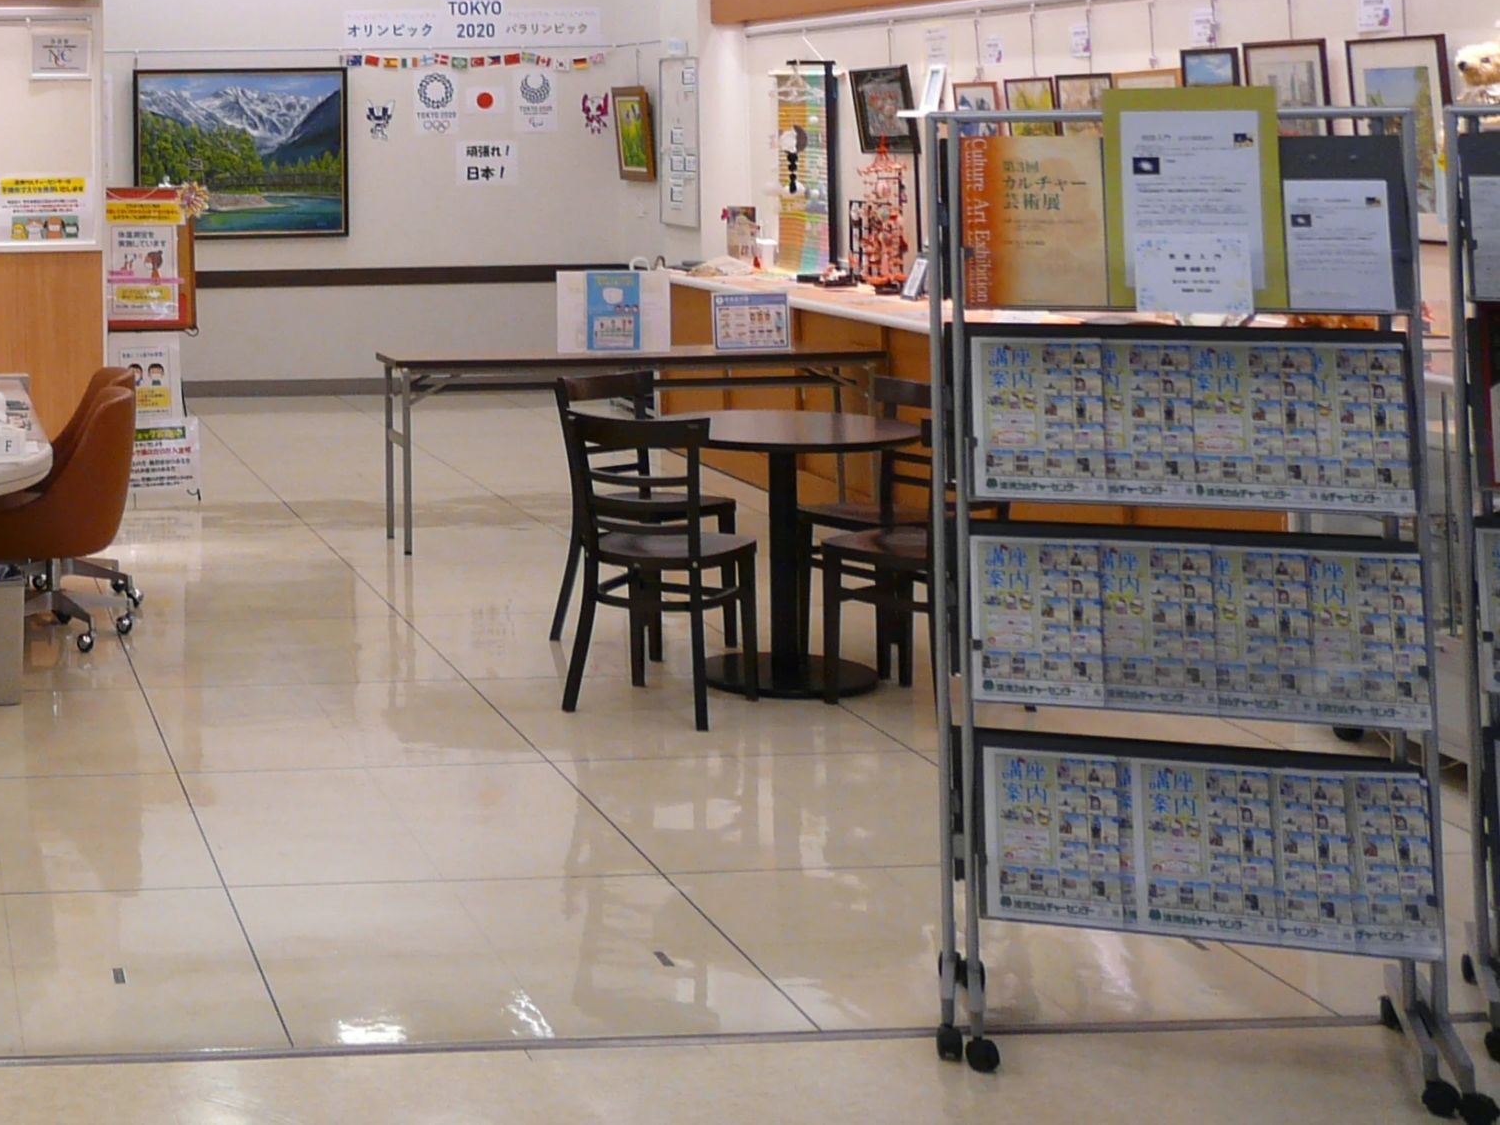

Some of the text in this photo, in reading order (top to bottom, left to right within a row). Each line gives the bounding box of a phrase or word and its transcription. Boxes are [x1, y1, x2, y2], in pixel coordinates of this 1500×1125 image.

[448, 0, 502, 16] TOKYO
[347, 23, 433, 38] オリンピック
[456, 22, 496, 38] 2020
[417, 111, 457, 119] TOKYO 2020
[467, 165, 505, 181] 日本！
[1002, 175, 1088, 191] カルチャー
[1003, 193, 1061, 211] 芸術展
[971, 138, 991, 303] Culture Art Exhibition
[5, 439, 13, 452] F
